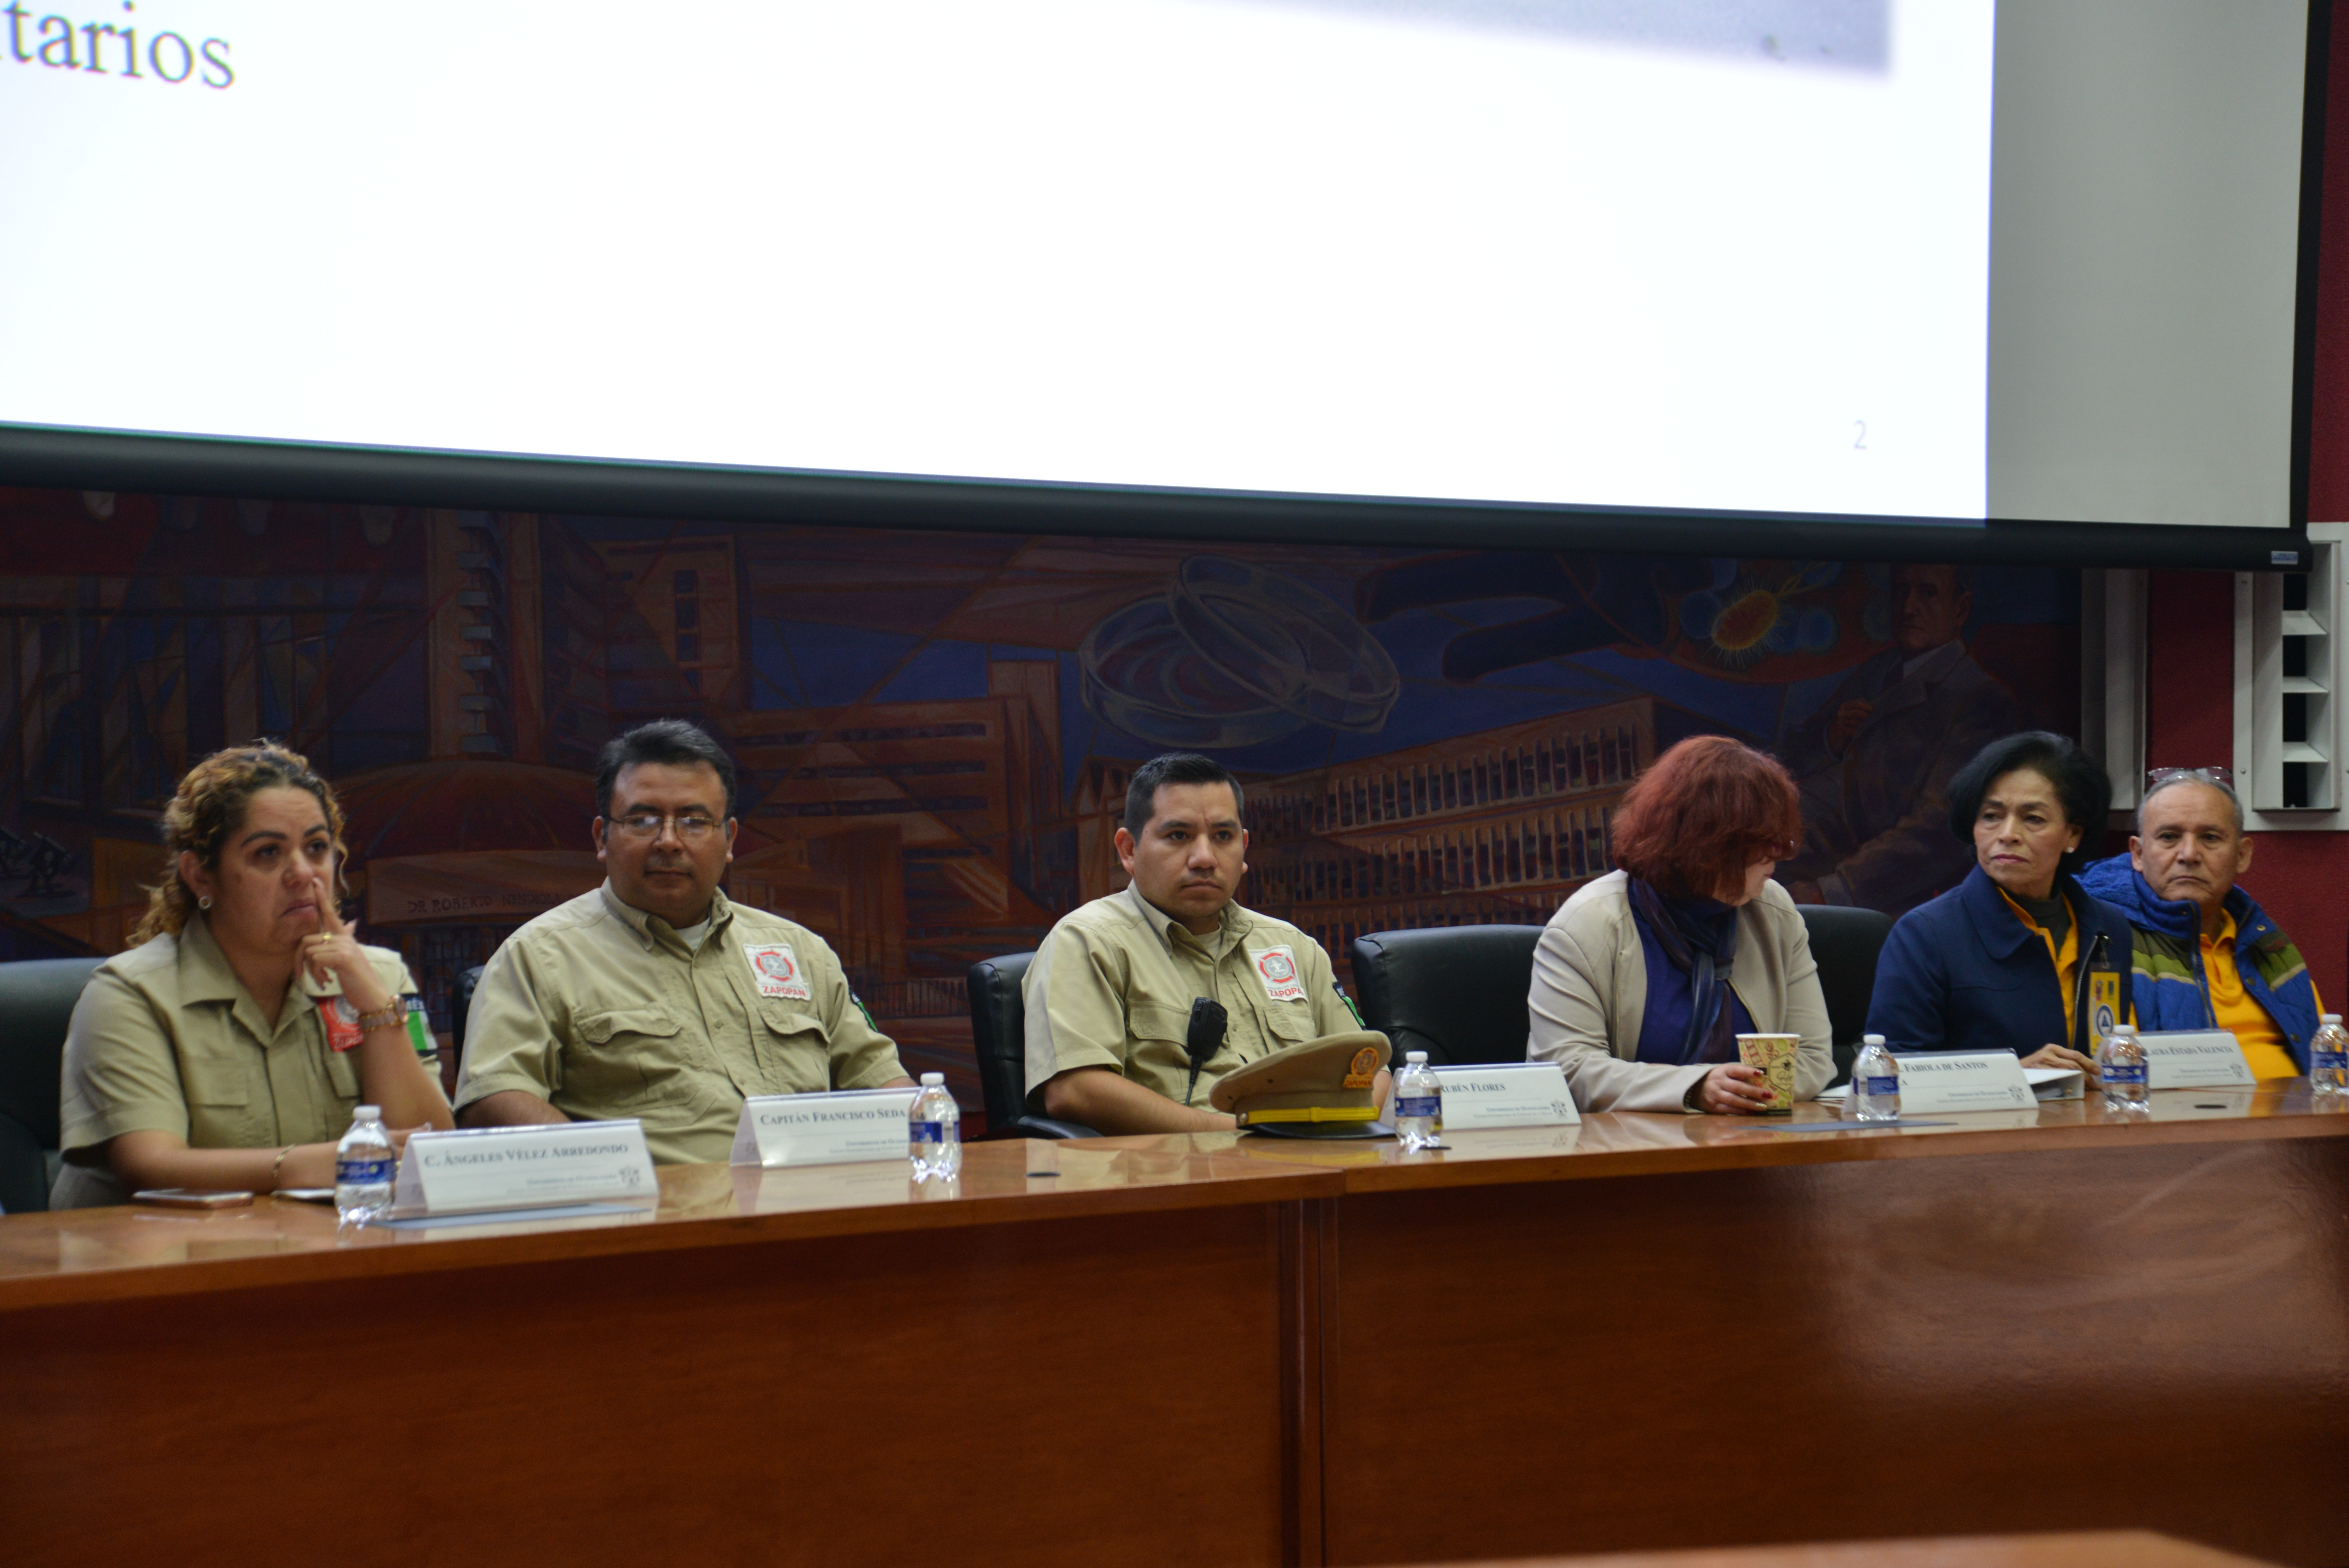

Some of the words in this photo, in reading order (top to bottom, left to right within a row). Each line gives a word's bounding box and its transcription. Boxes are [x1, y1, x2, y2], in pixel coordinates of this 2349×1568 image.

[1854, 420, 1867, 450] 2
[431, 896, 492, 912] ROBERTO
[762, 985, 806, 997] ZAPOPAN
[2197, 1046, 2234, 1054] VALENCIA
[1903, 1063, 1942, 1073] FABIOLA
[1955, 1061, 1988, 1070] SANTOS
[1440, 1083, 1469, 1093] RUBÉN
[1470, 1082, 1506, 1092] FLORES
[760, 1112, 810, 1126] CAPITÁN
[812, 1109, 875, 1122] FRANCISCO
[877, 1108, 906, 1119] SEDA
[424, 1154, 440, 1167] C.
[444, 1150, 504, 1167] ÁNGELES
[506, 1147, 548, 1161] VÉLEZ
[551, 1143, 628, 1158] ARREDONDO
